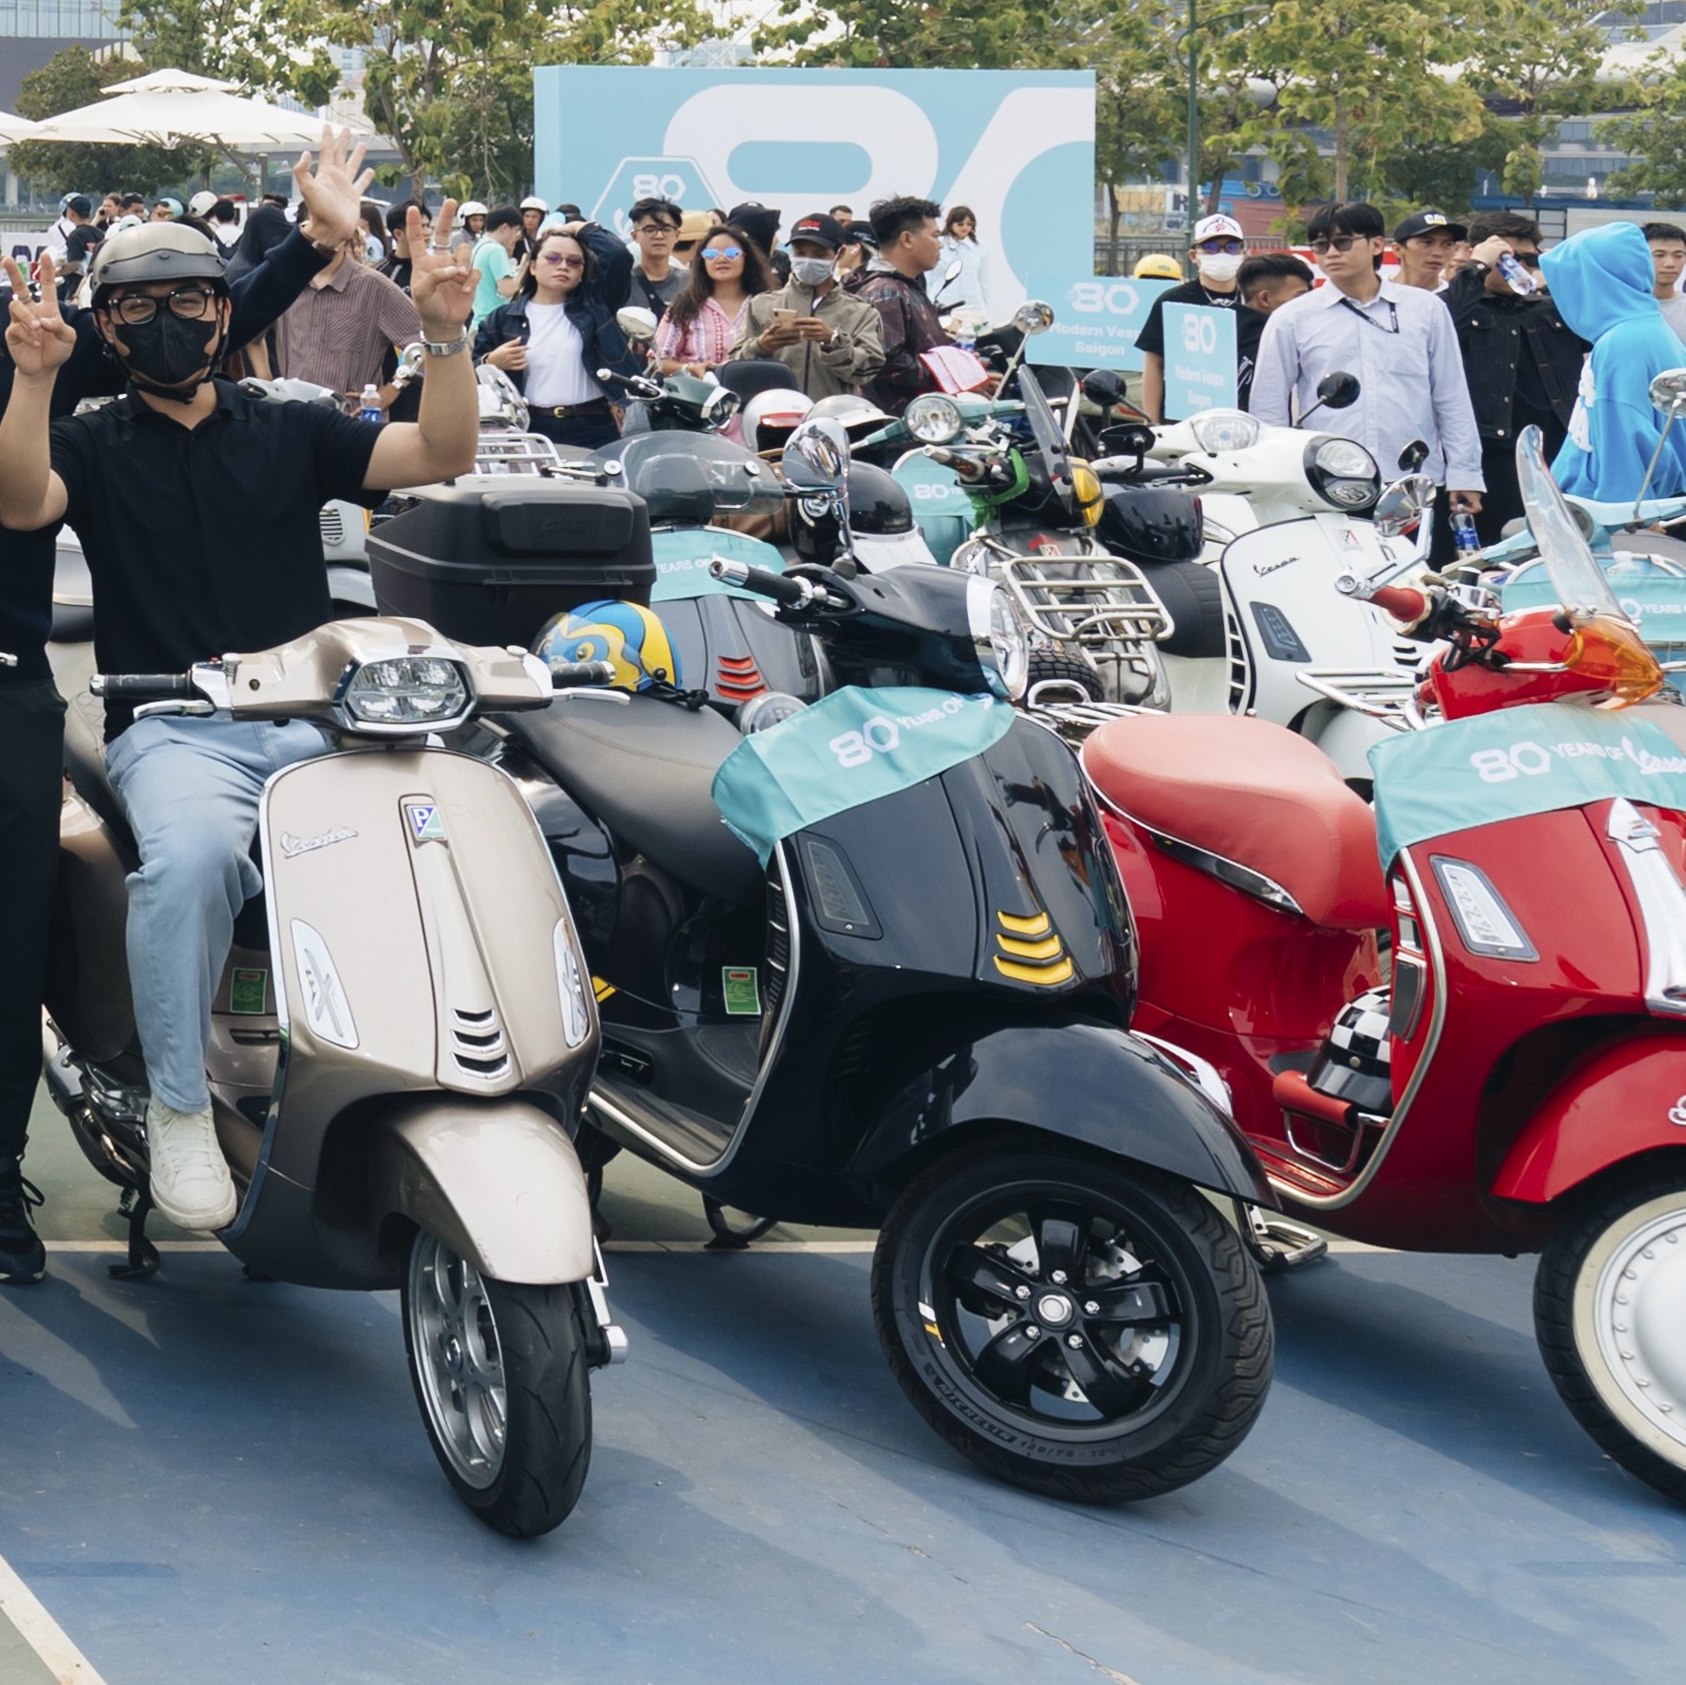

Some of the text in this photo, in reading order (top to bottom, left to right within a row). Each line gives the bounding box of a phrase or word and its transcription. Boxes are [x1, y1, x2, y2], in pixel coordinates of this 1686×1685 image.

[1070, 282, 1140, 315] 80
[1075, 340, 1126, 358] Saigon
[1183, 313, 1217, 355] 80
[830, 715, 900, 769] 80
[1470, 741, 1551, 783] 80
[1549, 742, 1606, 759] YEARS
[1605, 744, 1624, 761] OF
[413, 808, 430, 828] P
[937, 1381, 1013, 1442] MICHELIN
